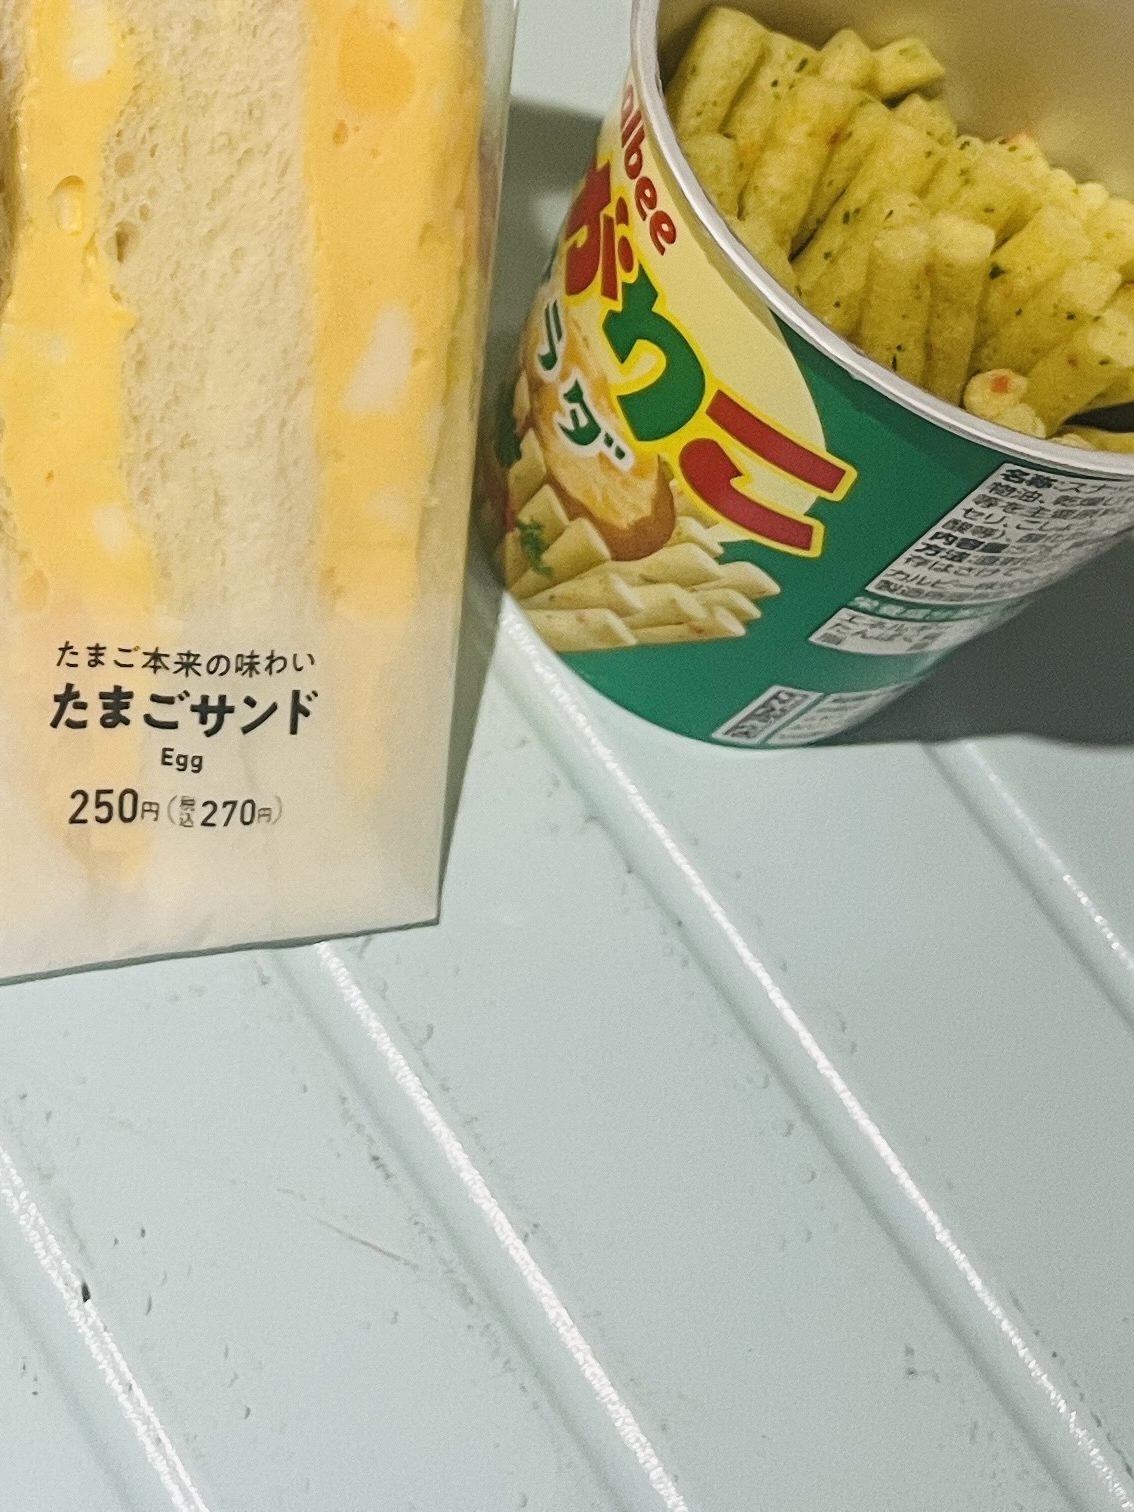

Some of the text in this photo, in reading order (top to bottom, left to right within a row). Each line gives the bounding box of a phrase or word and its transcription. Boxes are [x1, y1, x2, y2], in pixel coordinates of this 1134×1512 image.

[538, 278, 625, 459] ラダ
[56, 641, 315, 677] たまご本来の味わい
[50, 683, 318, 737] たまごサンド
[161, 748, 203, 773] Egg
